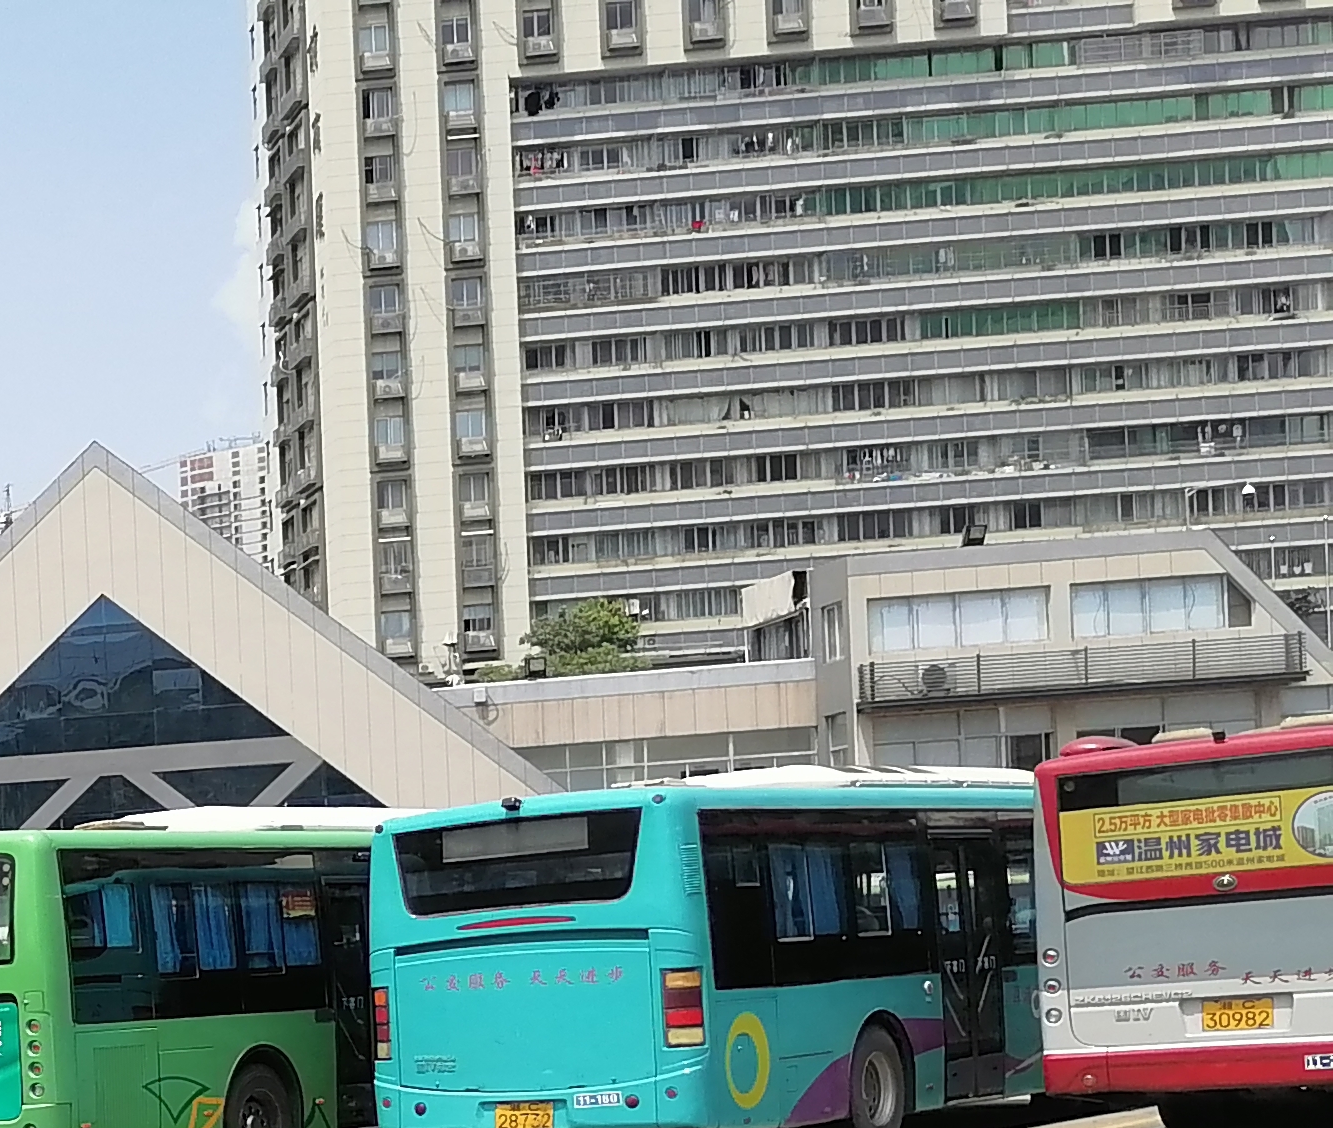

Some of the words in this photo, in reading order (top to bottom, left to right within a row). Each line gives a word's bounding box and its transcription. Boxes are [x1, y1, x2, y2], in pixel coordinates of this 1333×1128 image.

[1136, 825, 1283, 862] 温州家电城
[419, 970, 511, 991] 公交服务
[529, 965, 624, 986] 天天进步
[1124, 960, 1227, 980] 公交服务
[1205, 1010, 1271, 1029] 30982
